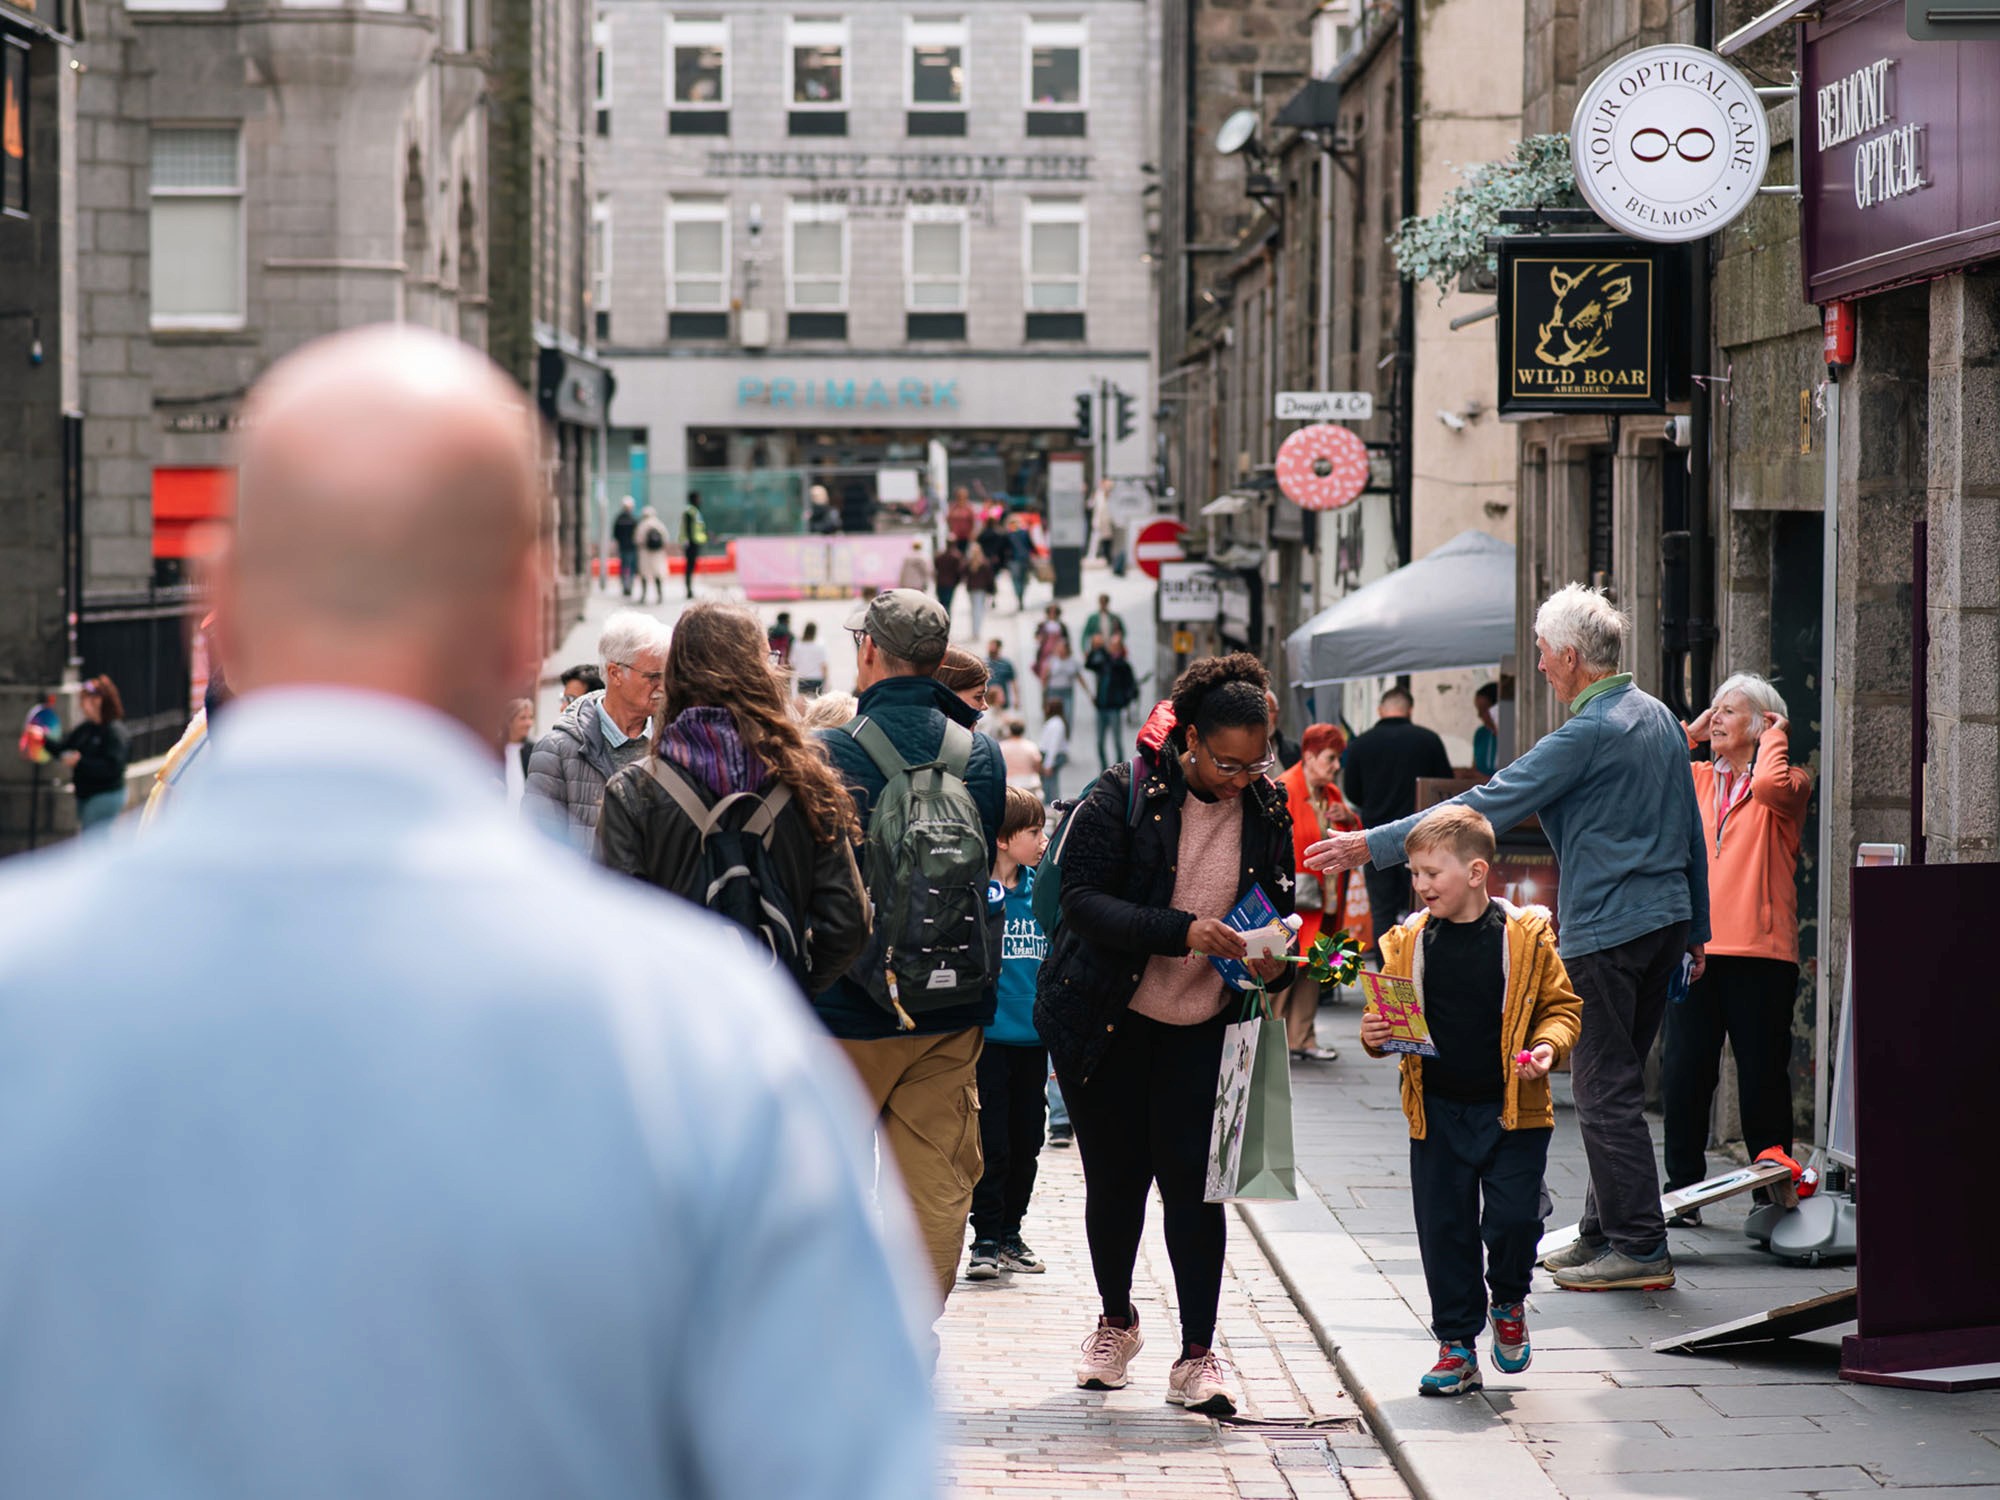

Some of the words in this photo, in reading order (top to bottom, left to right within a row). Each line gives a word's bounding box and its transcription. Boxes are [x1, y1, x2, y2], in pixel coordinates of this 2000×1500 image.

[1591, 98, 1622, 175] YOUR
[1618, 61, 1728, 102] OPTICAL
[1727, 101, 1755, 174] CARE
[1817, 57, 1889, 153] BELMONT
[1854, 122, 1921, 210] OPTICAL
[1624, 195, 1719, 226] BELMONT
[737, 376, 960, 409] PRIMARK
[1517, 368, 1576, 385] WILD
[1584, 369, 1646, 386] BOAR
[1553, 385, 1610, 393] ABERDEEN
